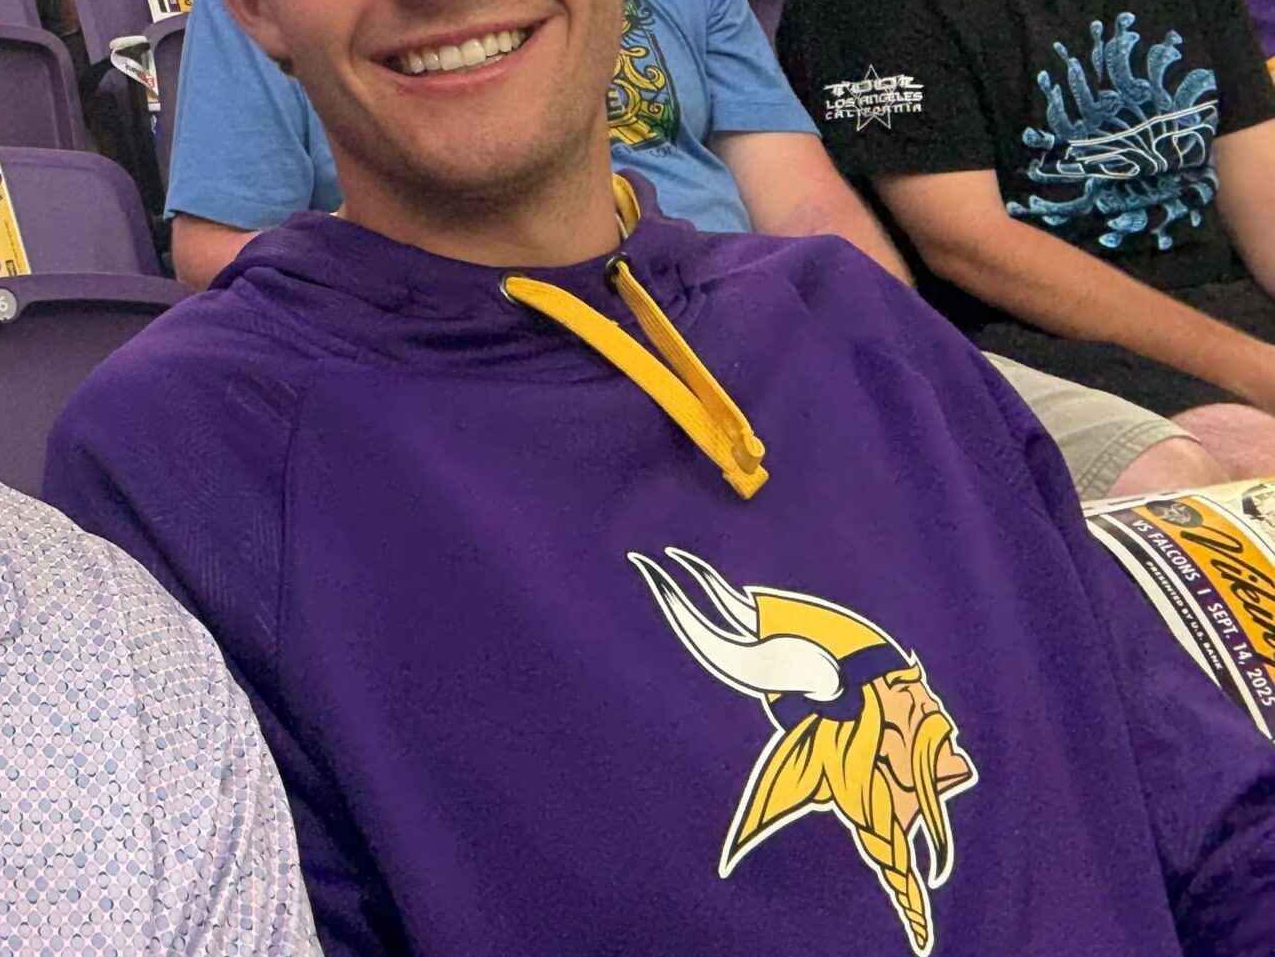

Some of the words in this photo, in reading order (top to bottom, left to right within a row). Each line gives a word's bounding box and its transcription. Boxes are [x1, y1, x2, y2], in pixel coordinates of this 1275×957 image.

[825, 97, 855, 110] LOS
[1132, 519, 1153, 532] VS
[1147, 530, 1201, 582] FALCONS
[1207, 602, 1239, 640] SEPT.
[1233, 642, 1250, 666] 14,
[1247, 667, 1275, 707] 2025
[1145, 561, 1184, 607] PRESENTED
[1181, 607, 1193, 619] BY
[1190, 621, 1204, 641] U.S.
[1202, 641, 1224, 670] BANK
